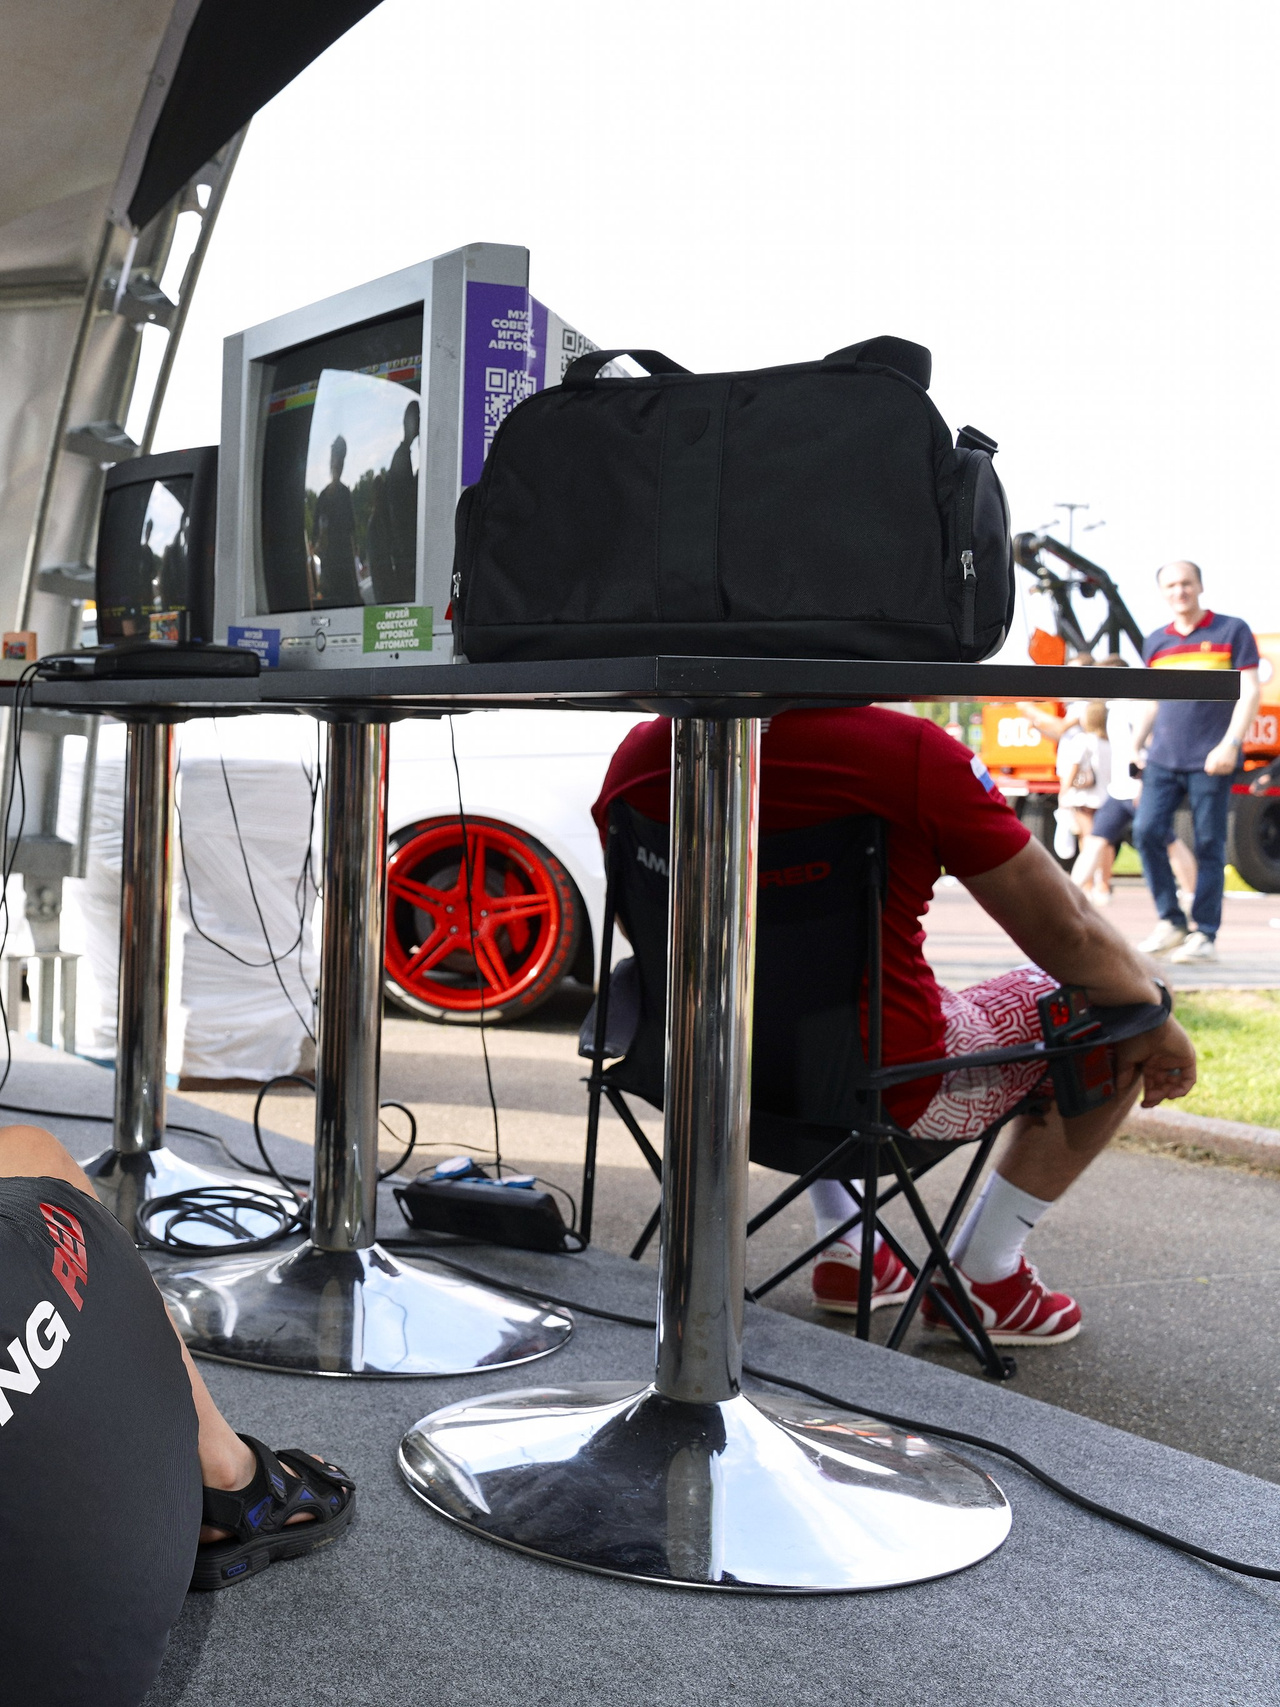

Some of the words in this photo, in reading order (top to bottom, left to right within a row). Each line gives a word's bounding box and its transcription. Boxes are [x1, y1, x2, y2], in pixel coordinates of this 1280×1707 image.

[385, 607, 410, 620] МУЗЕЙ
[376, 618, 418, 630] СОВЕТСКИХ
[374, 638, 419, 650] АВТОМАТОВ
[758, 862, 831, 888] RED
[39, 1202, 89, 1312] RED
